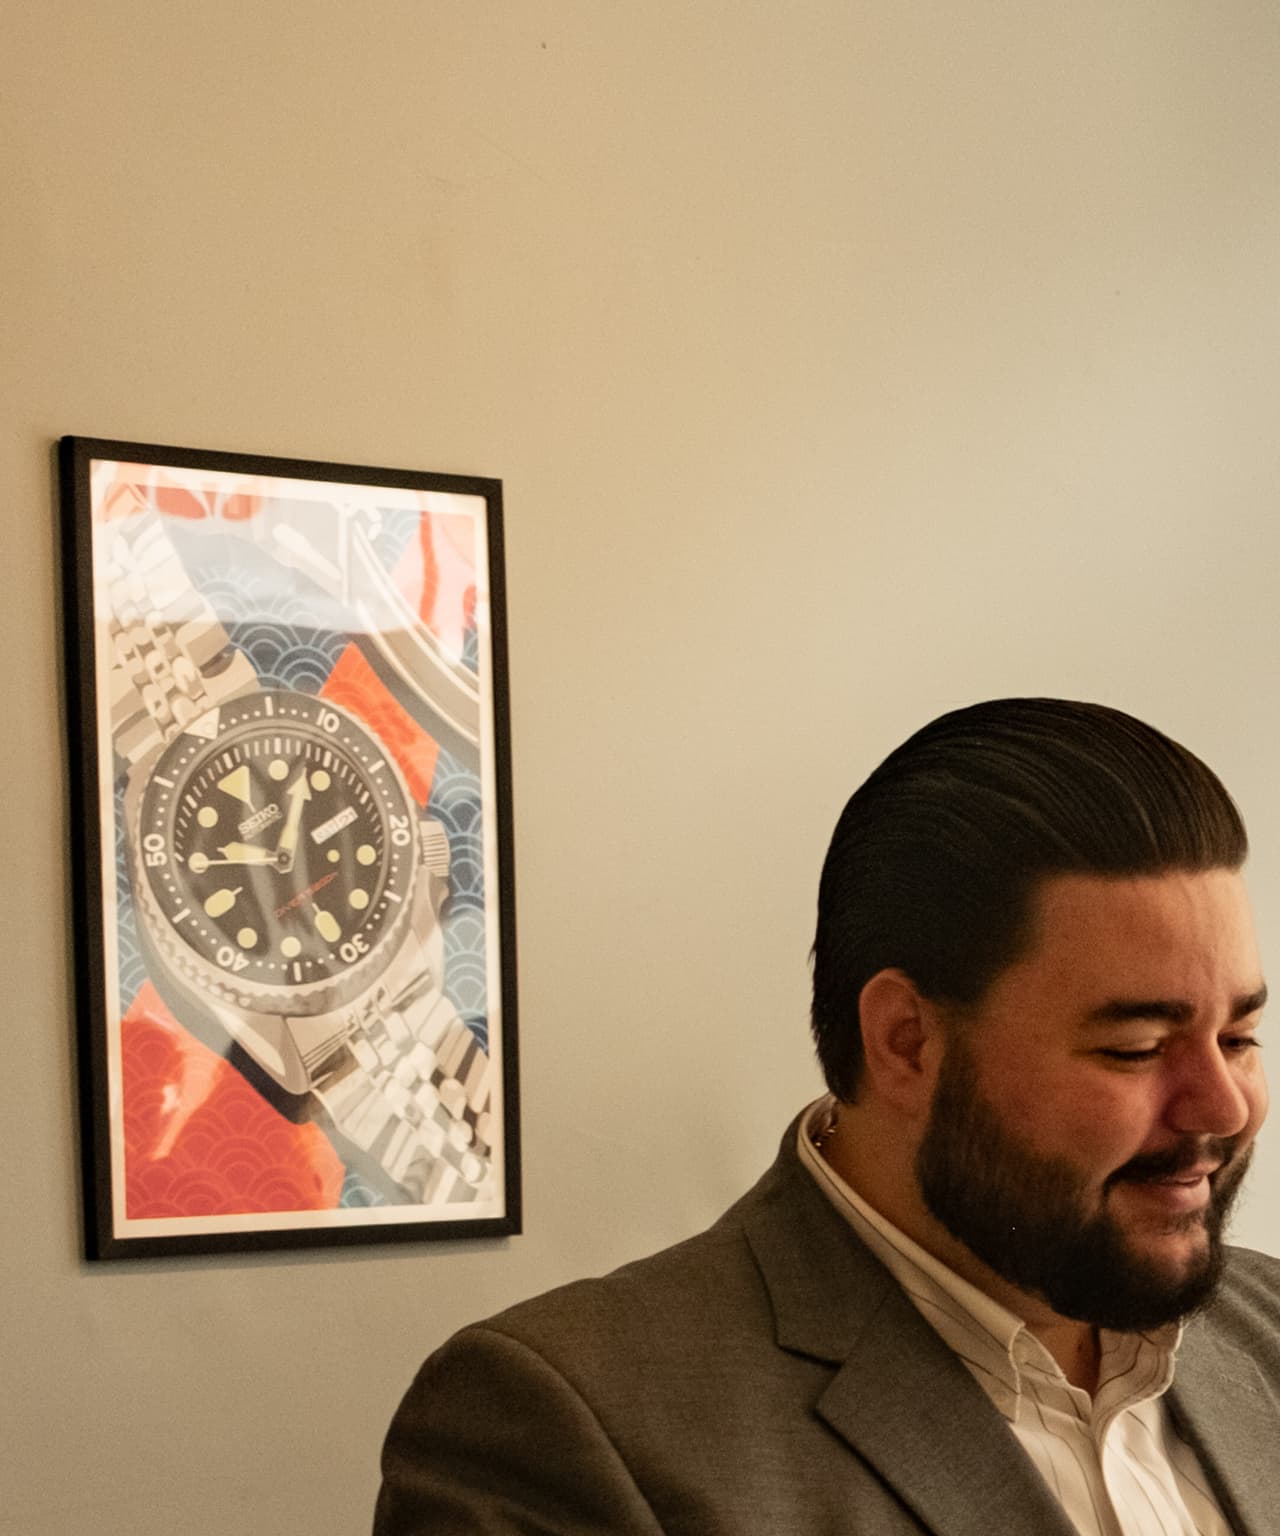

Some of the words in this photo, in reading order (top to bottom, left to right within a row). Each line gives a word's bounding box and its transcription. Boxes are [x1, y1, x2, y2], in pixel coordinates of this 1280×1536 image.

[316, 708, 340, 733] 10
[238, 803, 279, 835] SEIKO
[390, 814, 411, 846] 20
[143, 833, 167, 867] 50
[216, 946, 250, 972] 40
[340, 933, 370, 963] 30
